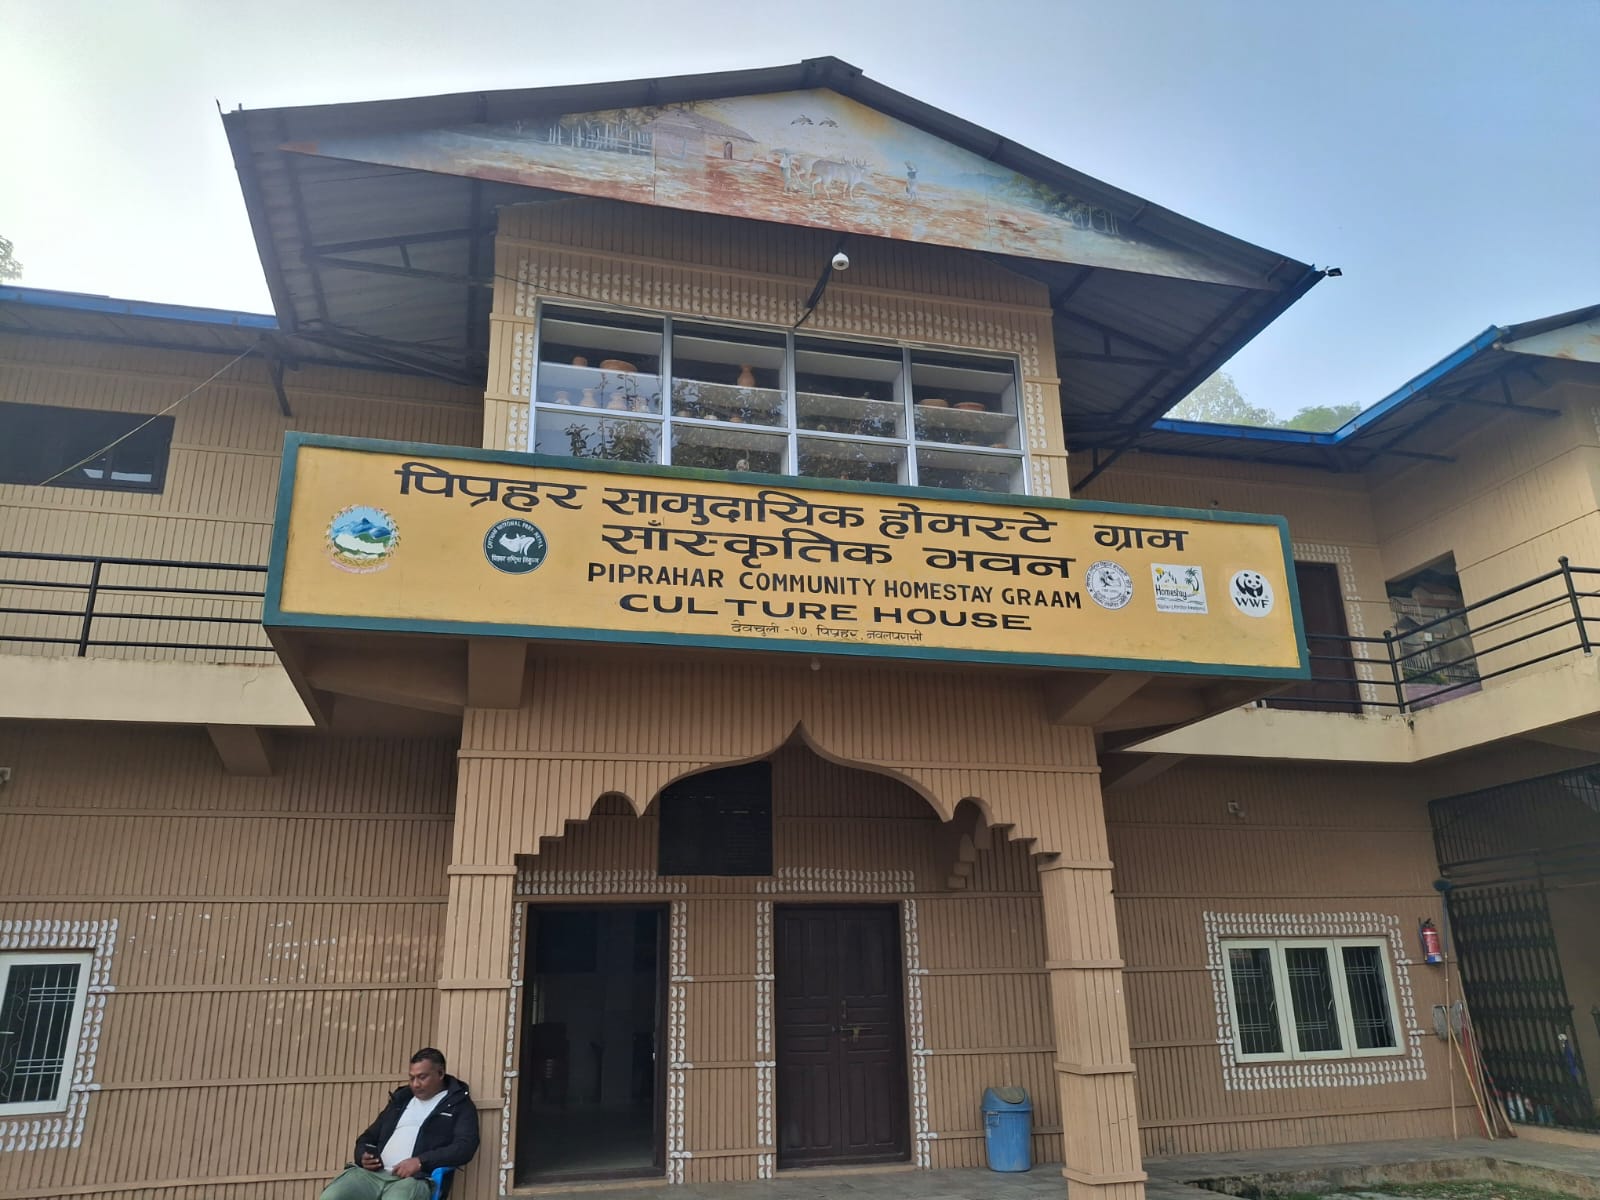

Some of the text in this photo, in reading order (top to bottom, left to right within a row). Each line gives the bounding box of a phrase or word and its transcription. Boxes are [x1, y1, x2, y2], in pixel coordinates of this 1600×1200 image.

[394, 461, 1189, 552] पिप्रहर सामुदायिक होमस्टे ग्राम
[922, 546, 1077, 579] भवन
[588, 562, 1082, 610] PIPRAHAR COMMUNITY HOMESTAY GRAAM
[1235, 597, 1270, 609] WWF
[619, 594, 1032, 631] CULTURE HOUSE
